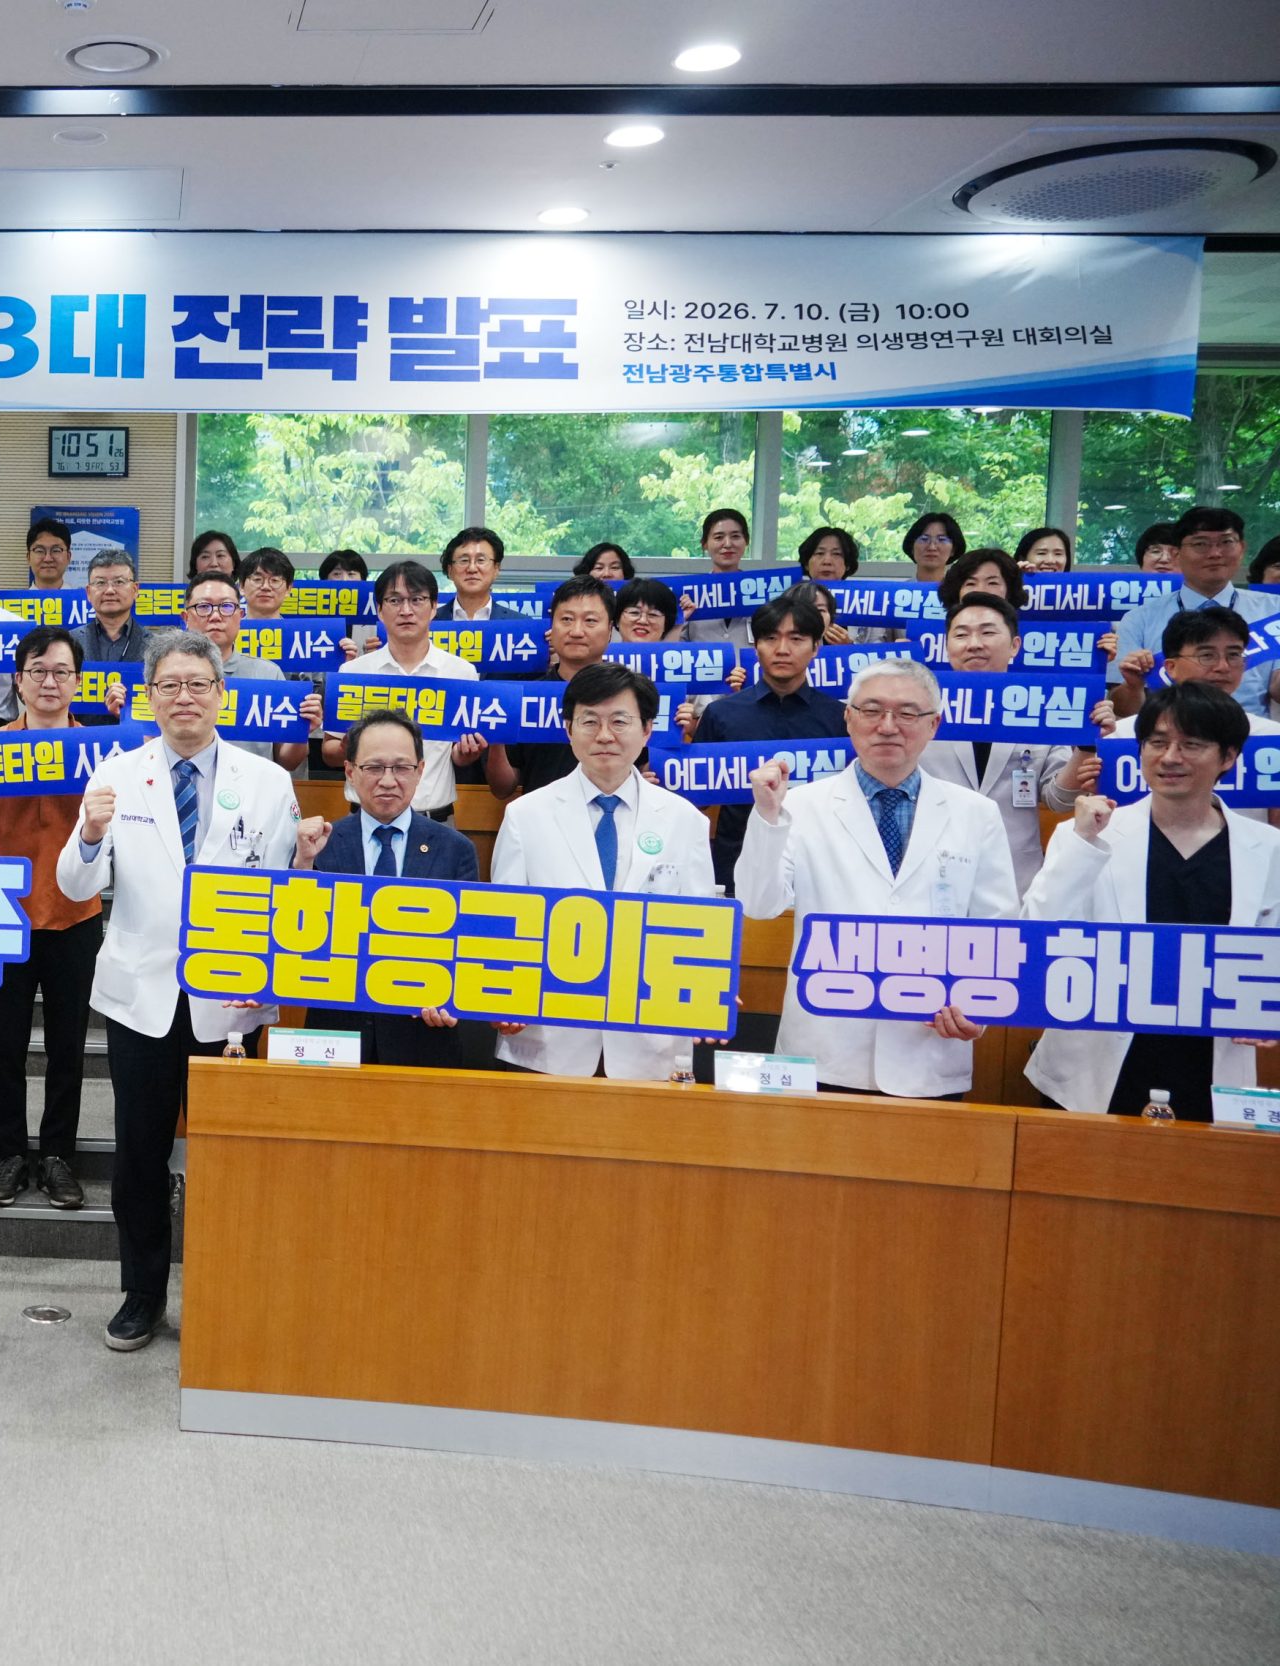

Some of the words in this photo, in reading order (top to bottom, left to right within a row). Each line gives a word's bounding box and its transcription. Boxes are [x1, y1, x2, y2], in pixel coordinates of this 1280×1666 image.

[624, 299, 676, 320] 일시:
[684, 302, 757, 321] 2026.
[764, 302, 786, 321] 7.
[793, 302, 829, 321] 10.
[839, 302, 880, 323] (금)
[895, 302, 969, 321] 10:00
[172, 295, 368, 381] 전략
[389, 296, 579, 382] 발표
[623, 332, 676, 353] 장소:
[683, 331, 848, 354] 전남대학교병원
[856, 328, 1004, 351] 의생명연구원
[1013, 324, 1113, 347] 대회의실
[622, 361, 837, 384] 전남광주통합특별시
[135, 589, 187, 616] 골든
[281, 588, 359, 616] 골든타임
[683, 582, 737, 609] 디서나
[831, 588, 893, 617] 디서나
[1021, 584, 1106, 611] 어디서나
[235, 628, 283, 661] 타임
[289, 631, 335, 659] 사수
[429, 630, 483, 663] 타임
[489, 633, 538, 662] 사수
[1023, 631, 1095, 668] 안심
[662, 649, 724, 682] 안심
[244, 694, 298, 729] 사수
[336, 684, 447, 727] 골든타임
[451, 695, 508, 730] 사수
[940, 688, 995, 725] 서나
[1001, 685, 1087, 729] 안심
[183, 872, 735, 1031] 통합응급의료
[801, 921, 1027, 1018] 생명망
[1045, 928, 1280, 1031] 하나로
